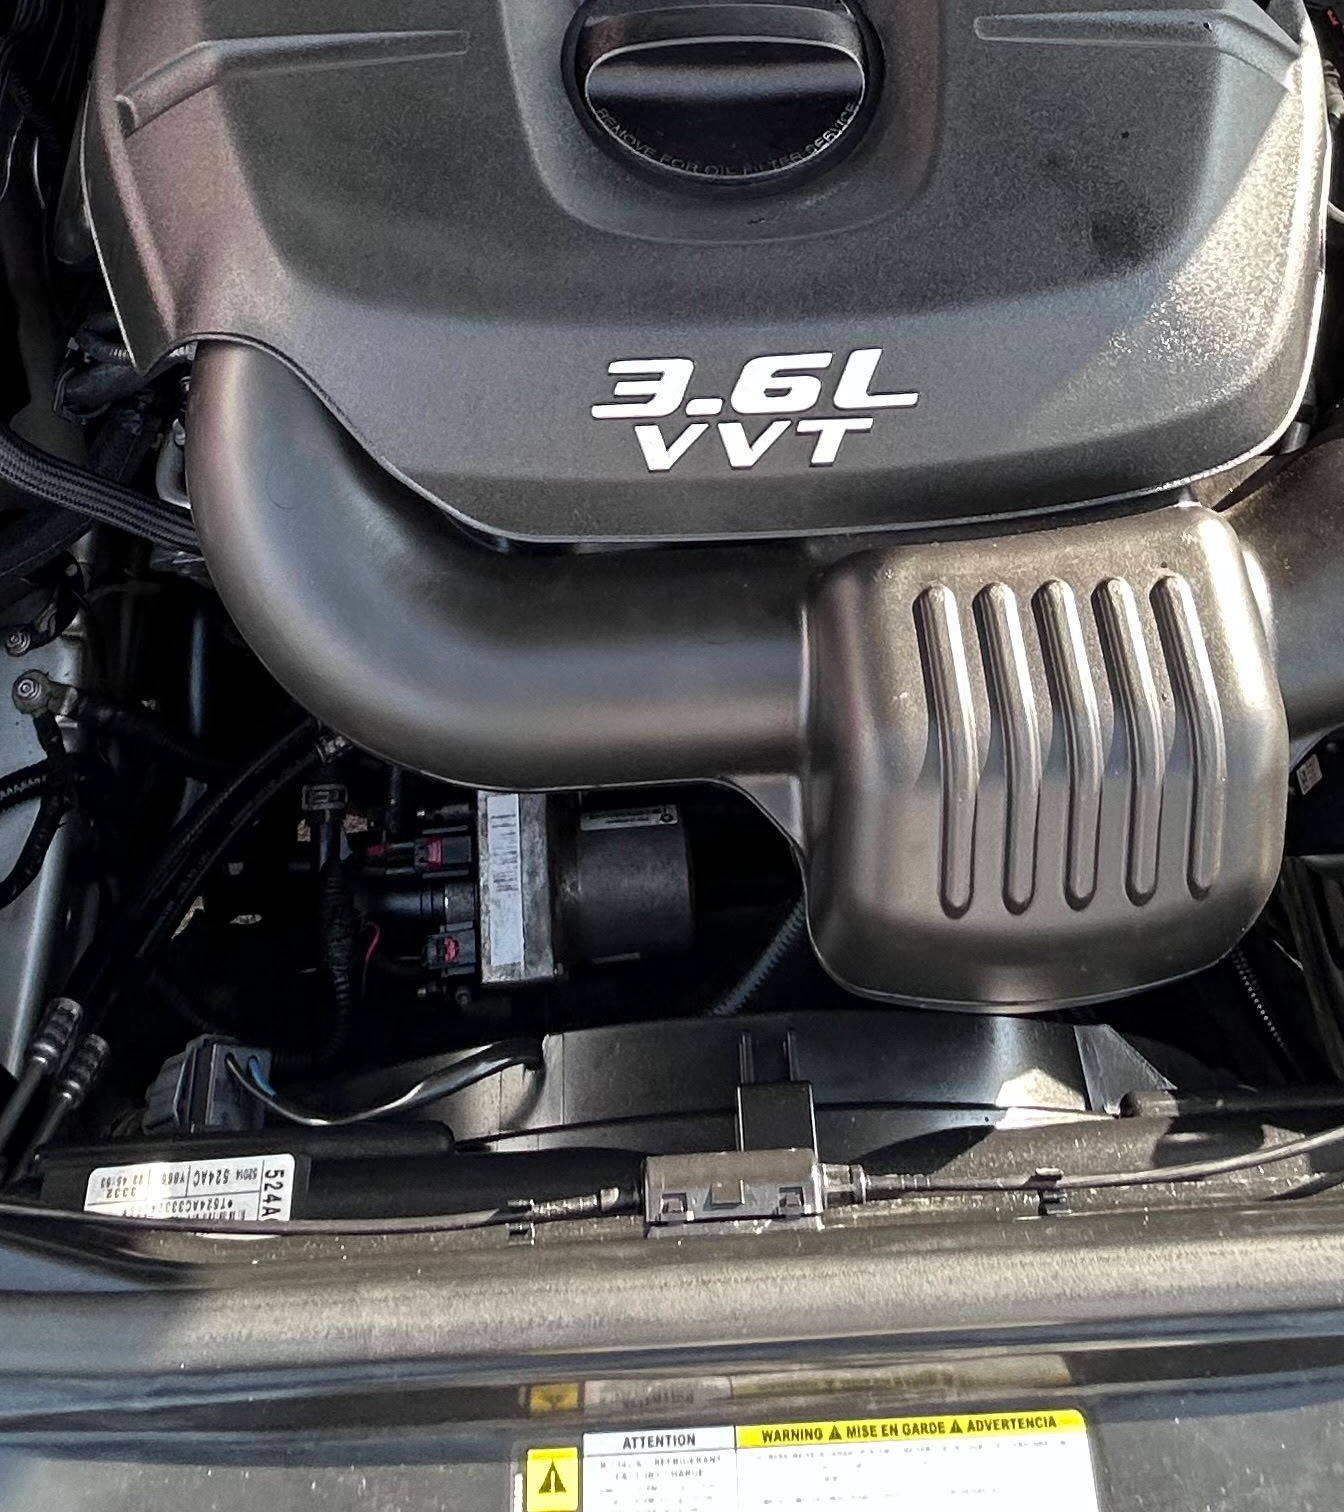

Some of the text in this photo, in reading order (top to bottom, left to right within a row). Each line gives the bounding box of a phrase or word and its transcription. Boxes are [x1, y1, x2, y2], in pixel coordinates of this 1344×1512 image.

[595, 107, 658, 157] REMOVE
[659, 153, 699, 174] FOR
[804, 101, 858, 157] SERVICE
[590, 347, 920, 420] 3.6L
[633, 417, 875, 472] VVT
[192, 1169, 231, 1188] 524AC
[262, 1169, 285, 1220] 524A
[622, 1432, 697, 1450] ATTENTION
[761, 1414, 1058, 1444] WARNING MISE EN GARDE ADVERTENCIA
